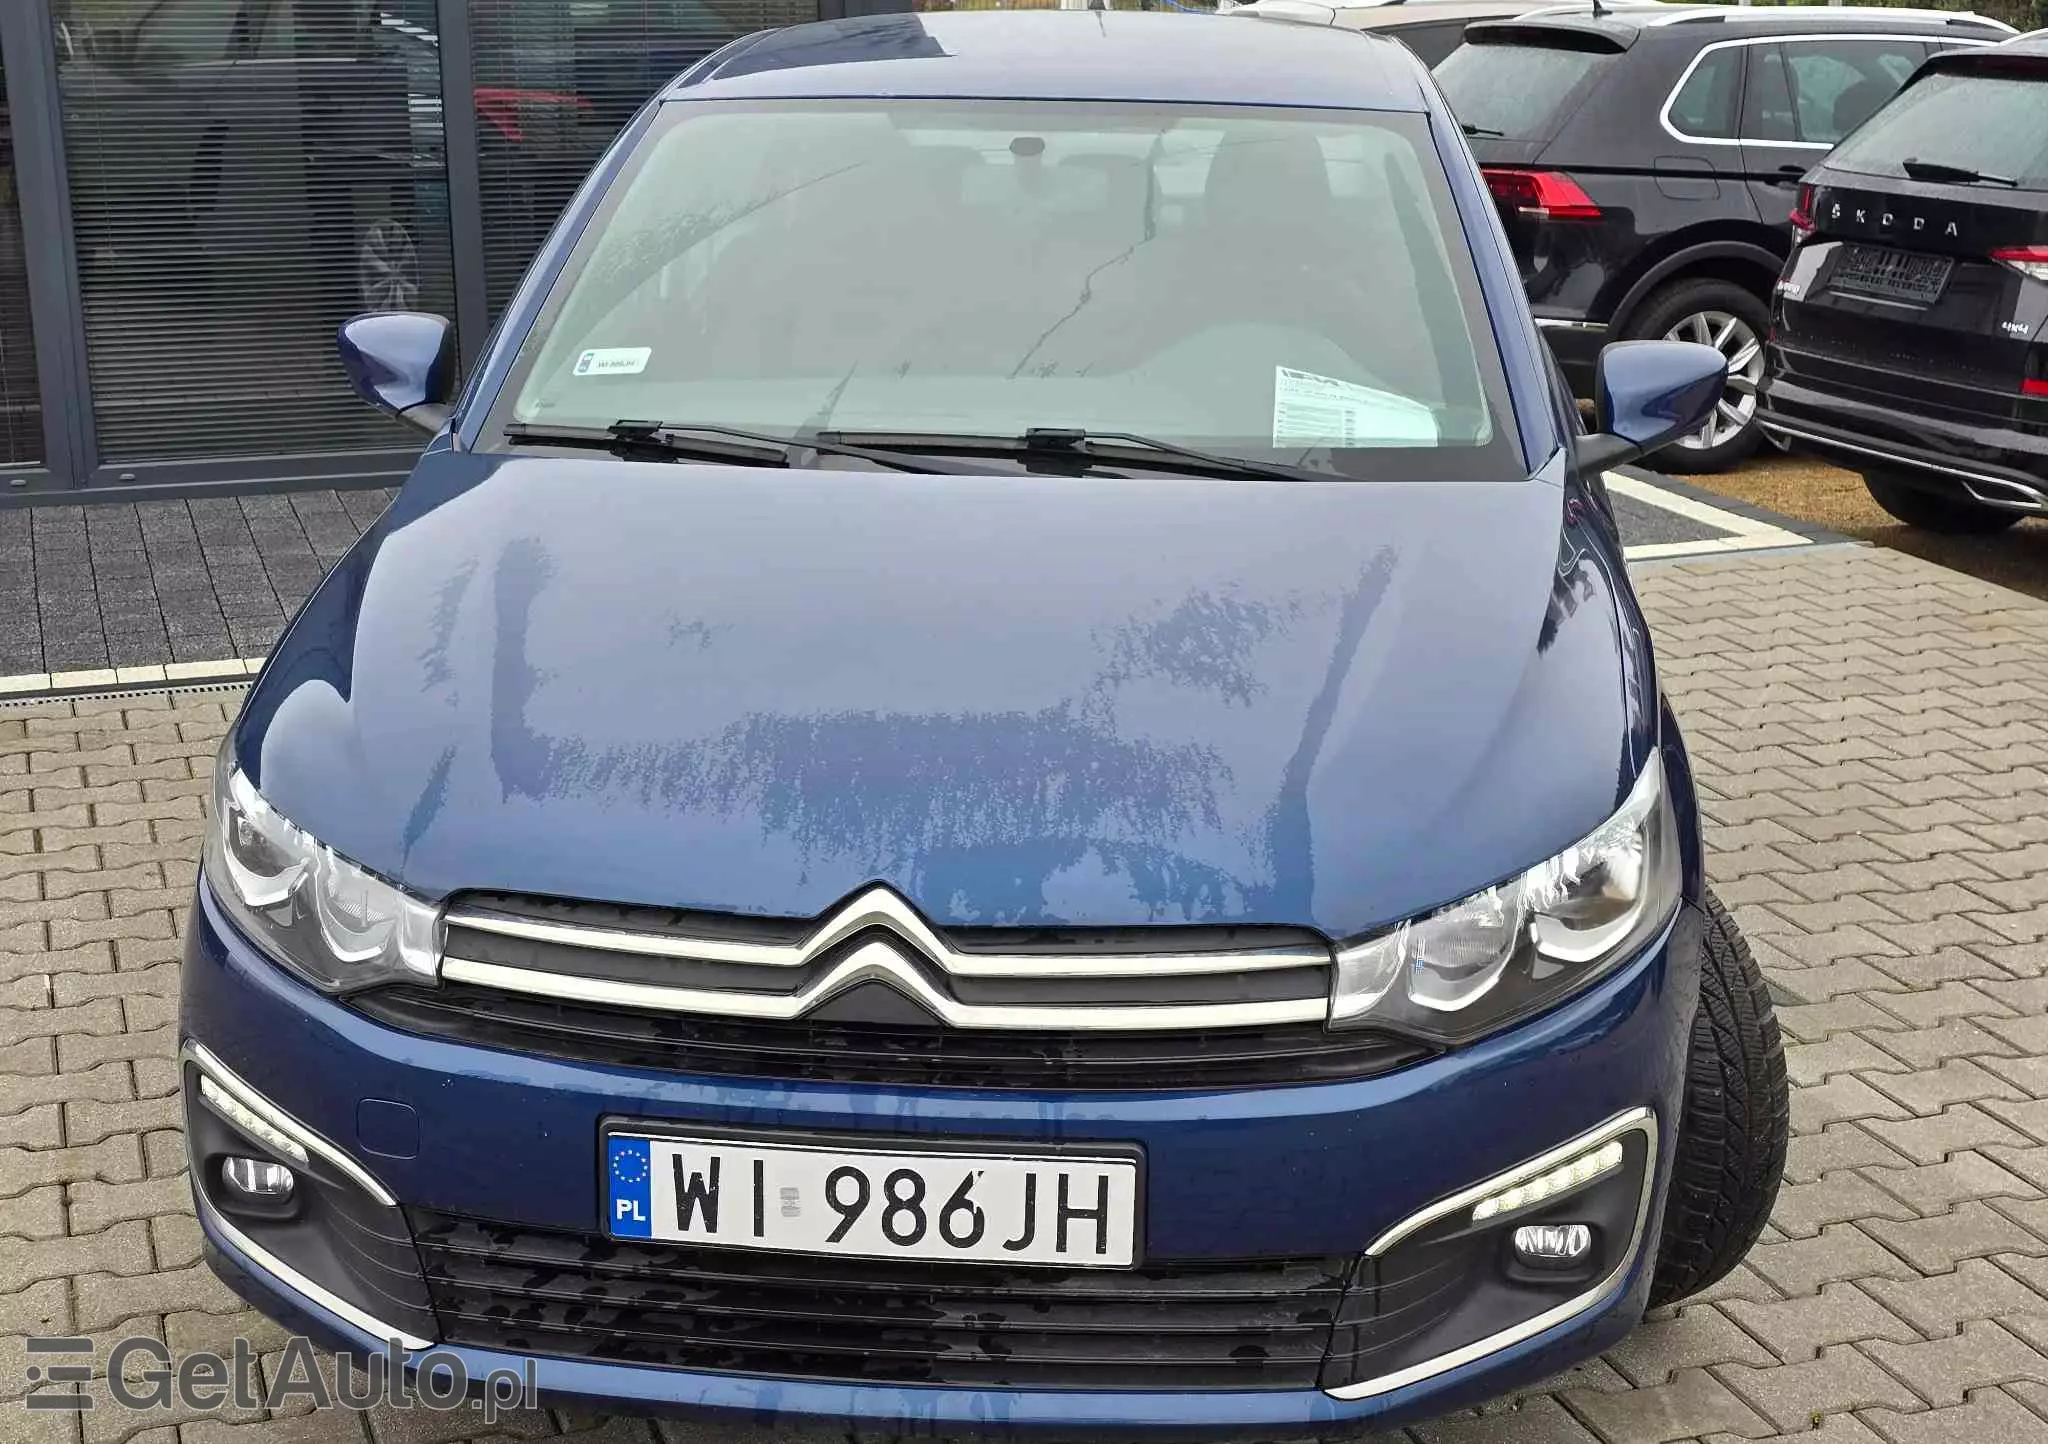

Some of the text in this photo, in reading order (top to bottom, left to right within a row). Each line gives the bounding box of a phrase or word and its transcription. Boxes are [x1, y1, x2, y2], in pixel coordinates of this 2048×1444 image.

[616, 1199, 646, 1221] PL
[671, 1153, 1110, 1254] WI 986JH
